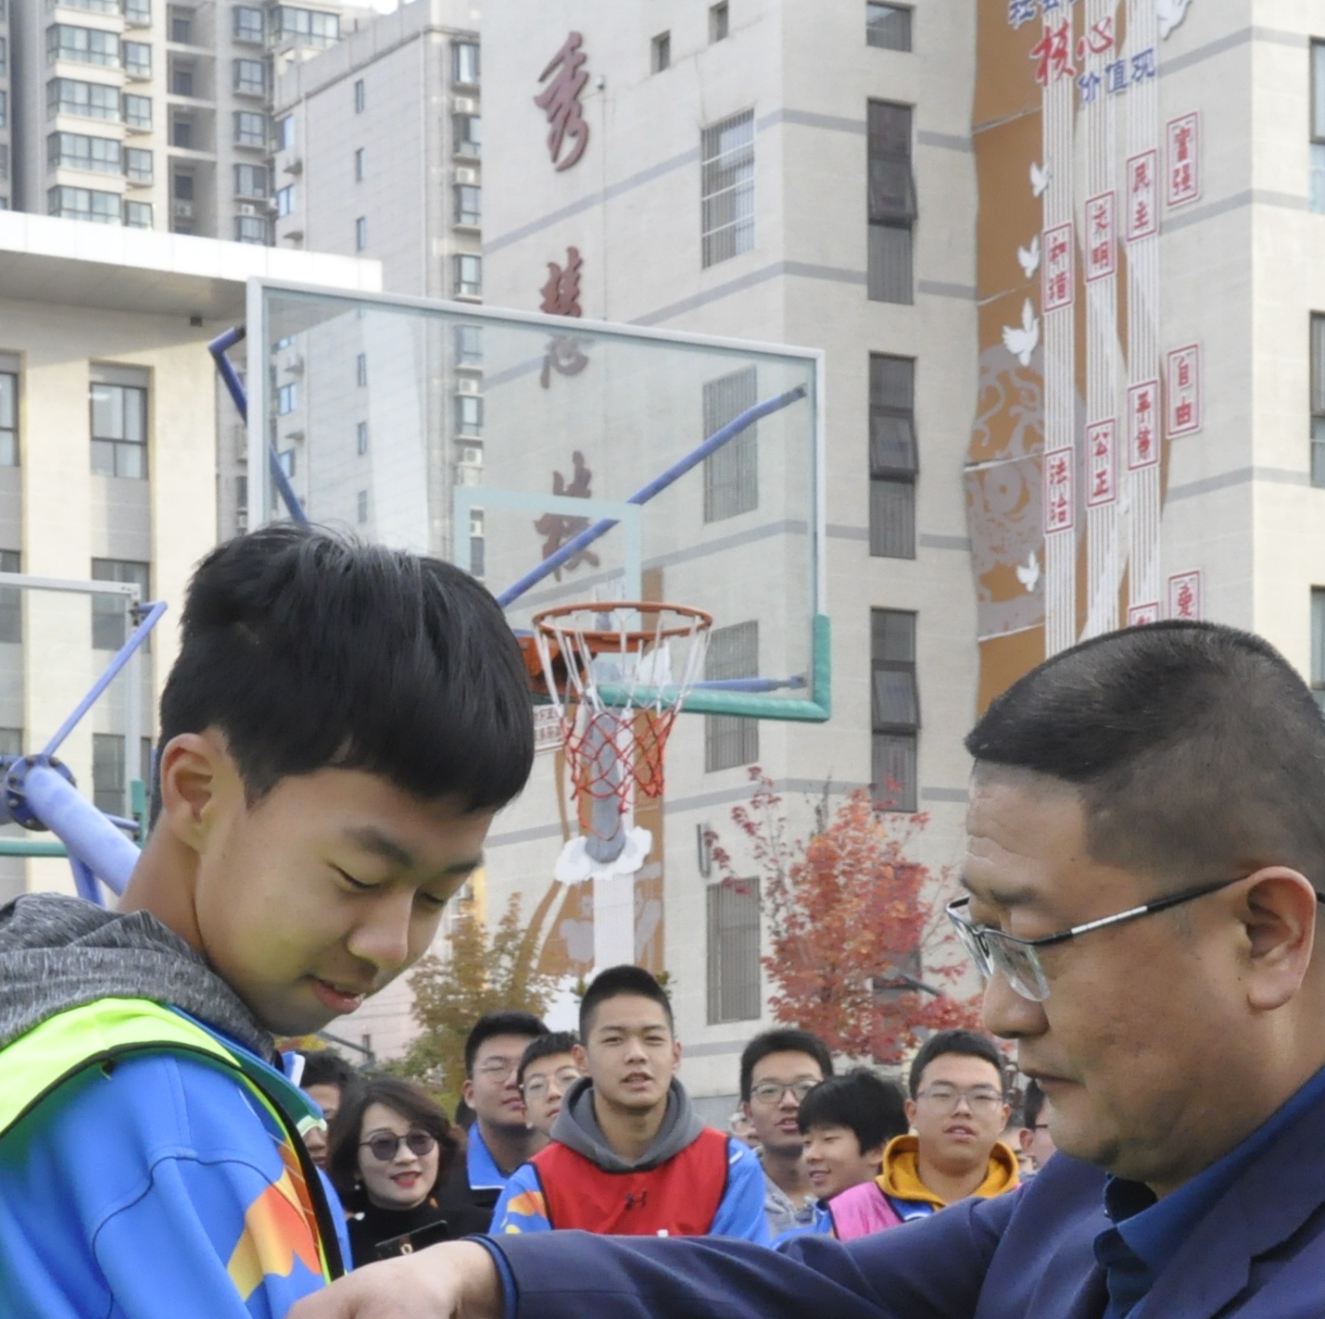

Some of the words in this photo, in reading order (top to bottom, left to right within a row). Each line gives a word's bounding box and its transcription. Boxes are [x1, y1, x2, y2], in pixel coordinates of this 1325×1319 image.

[1030, 17, 1114, 87] 核心
[1078, 48, 1156, 101] 价值观
[1172, 126, 1193, 196] 富强
[1133, 162, 1151, 230] 民主
[1049, 235, 1067, 300] 和谐
[1092, 203, 1110, 269] 文明
[1136, 391, 1152, 459] 平等
[1175, 357, 1192, 426] 自由
[1050, 459, 1068, 522] 法治
[1093, 431, 1110, 497] 公正
